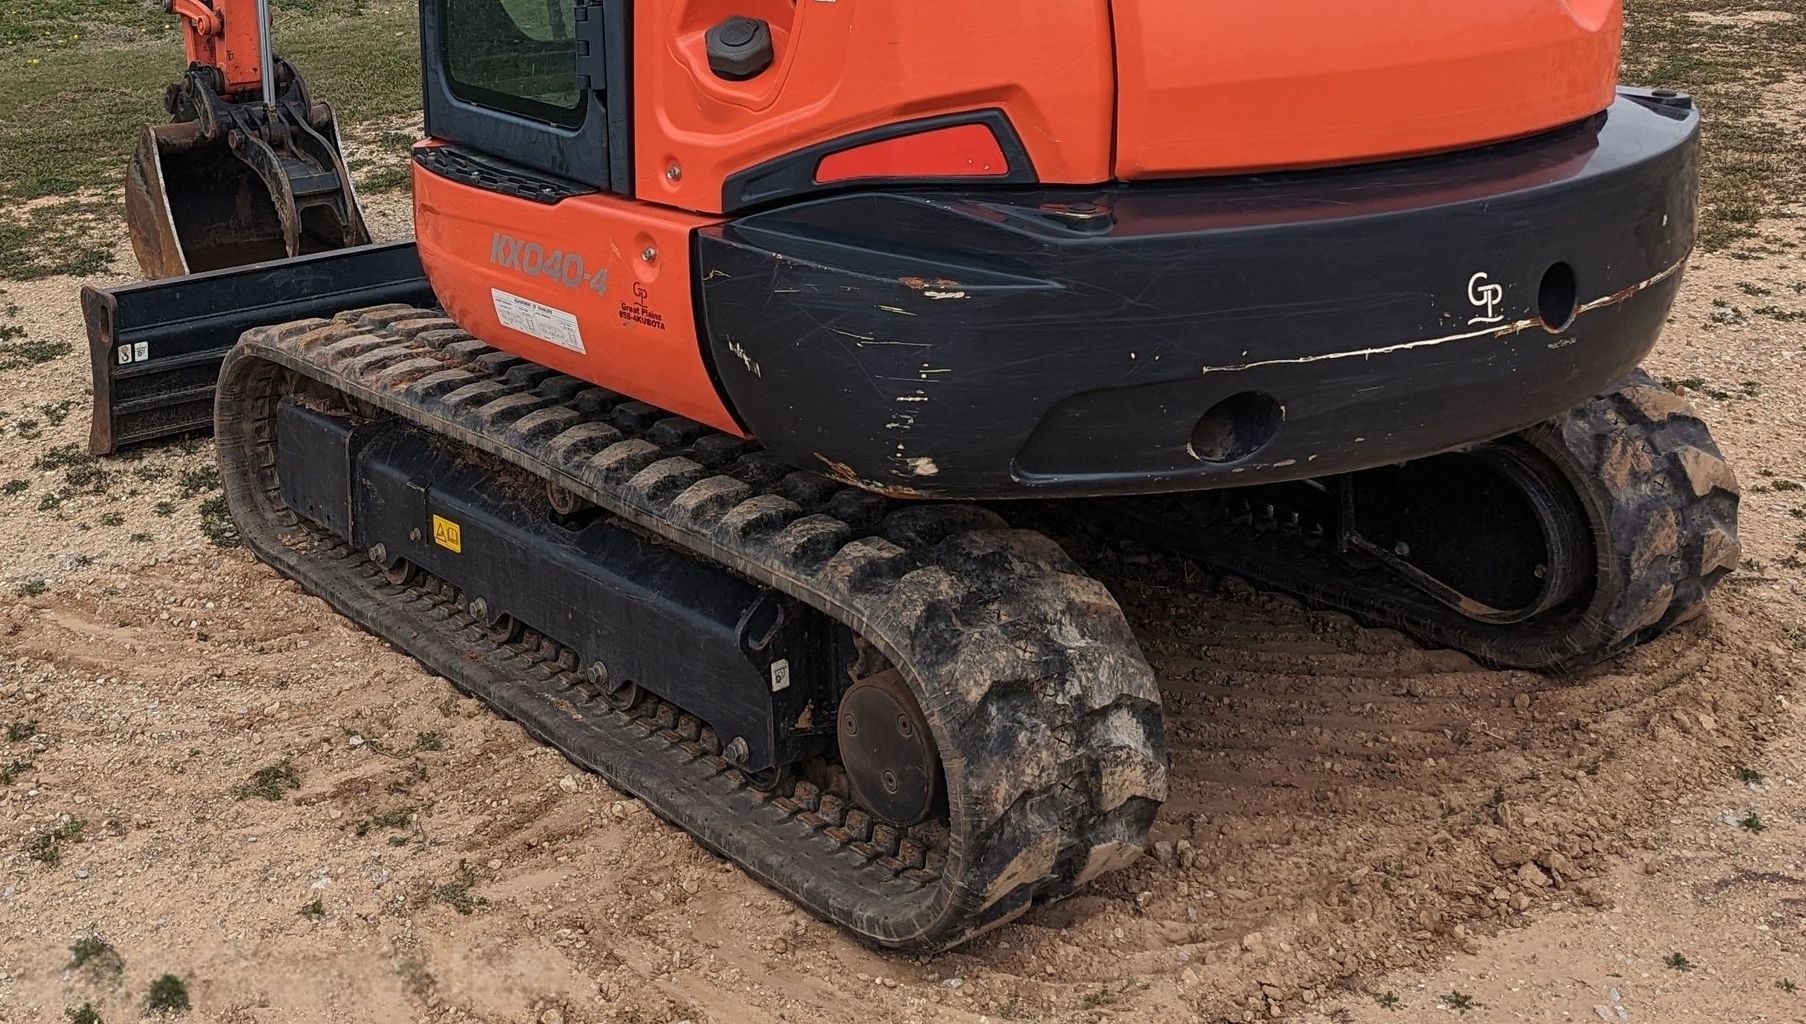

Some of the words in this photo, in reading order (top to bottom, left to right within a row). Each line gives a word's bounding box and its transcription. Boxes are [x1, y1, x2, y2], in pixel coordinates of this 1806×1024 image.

[491, 232, 608, 296] KX040-4
[621, 302, 640, 315] Great
[641, 308, 662, 321] Plains
